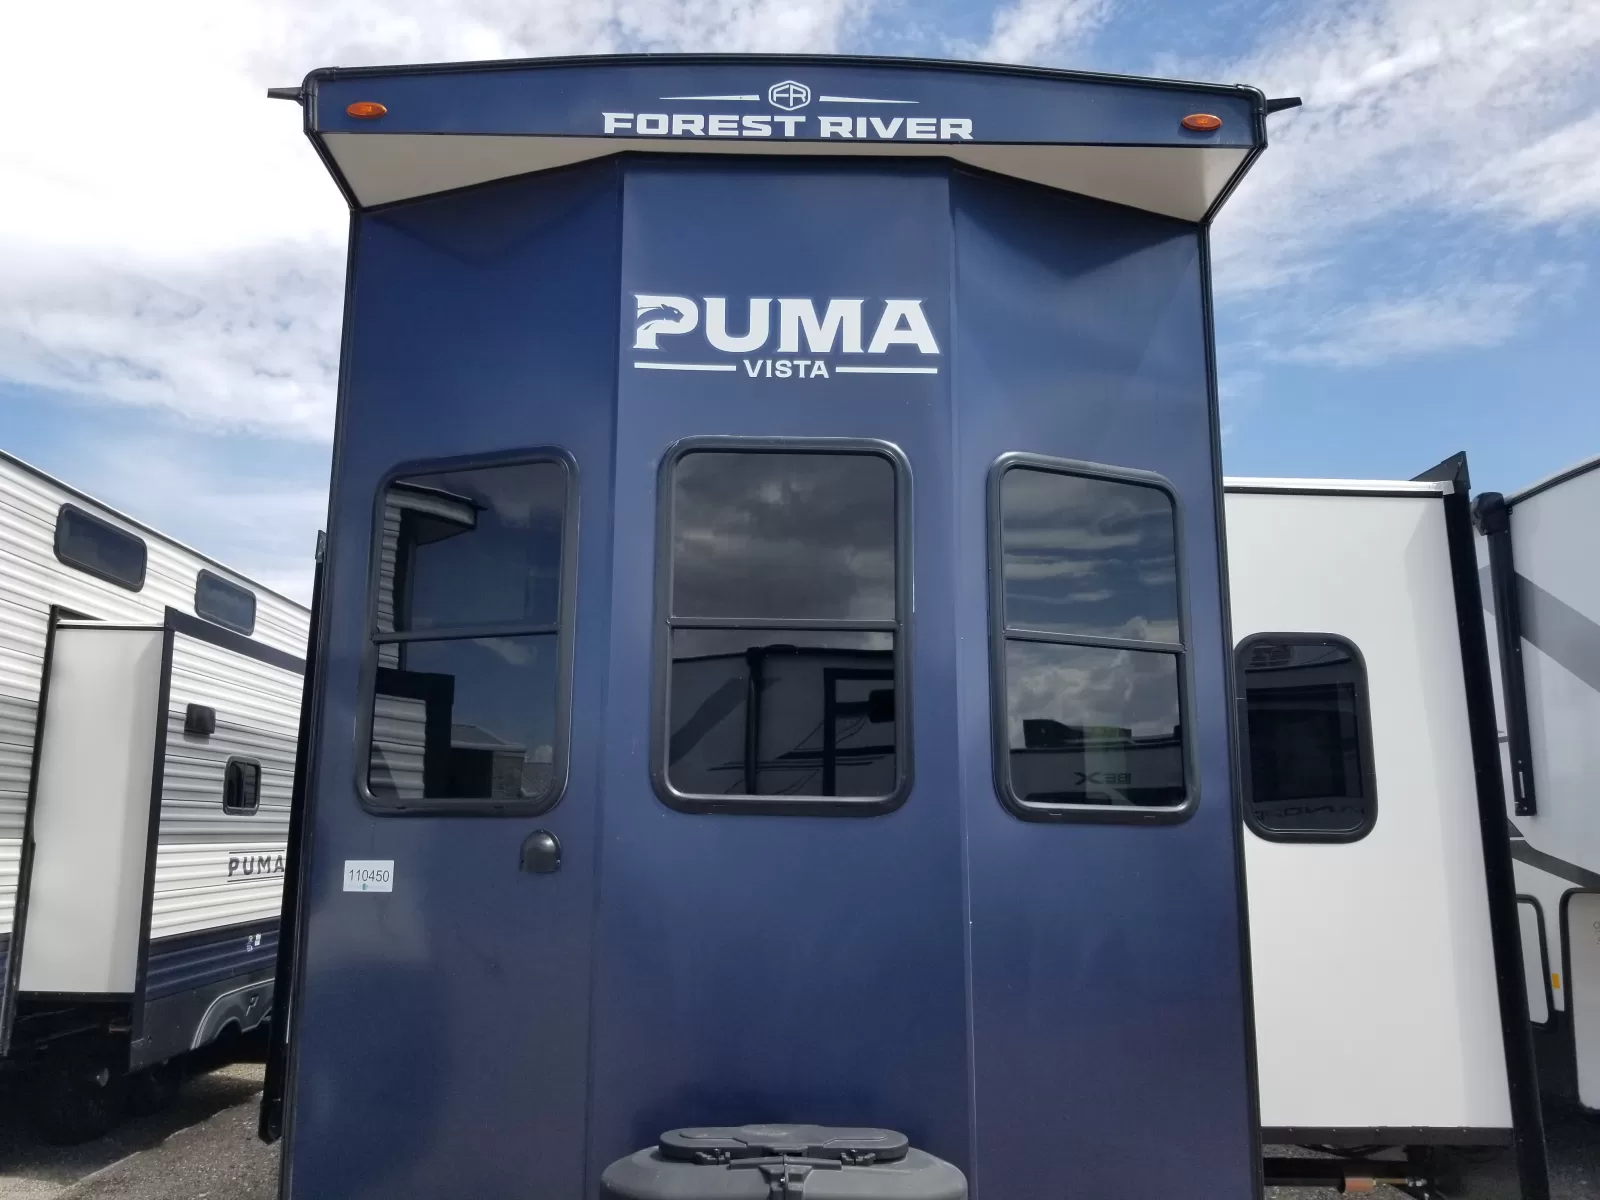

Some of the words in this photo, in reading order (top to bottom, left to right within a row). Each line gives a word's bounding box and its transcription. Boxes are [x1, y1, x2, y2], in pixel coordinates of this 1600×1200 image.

[602, 112, 806, 137] FOREST
[817, 116, 974, 140] RIVER
[633, 294, 941, 354] PUMA
[743, 359, 830, 379] VISTA
[227, 854, 285, 877] PUMA
[349, 869, 390, 883] 110450
